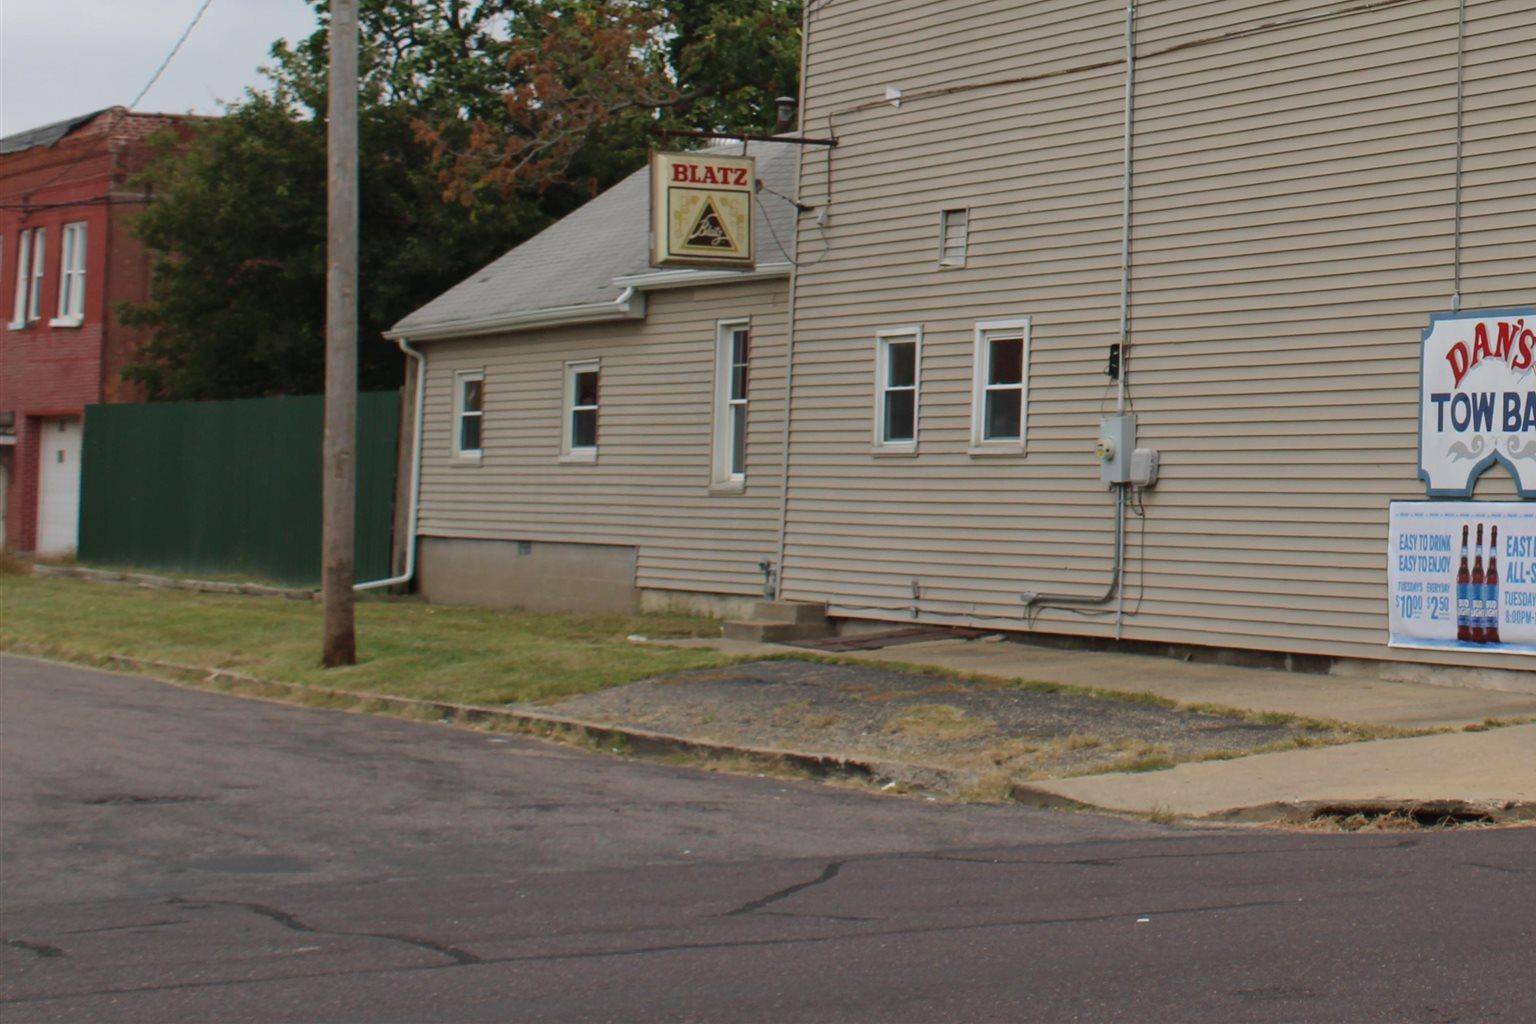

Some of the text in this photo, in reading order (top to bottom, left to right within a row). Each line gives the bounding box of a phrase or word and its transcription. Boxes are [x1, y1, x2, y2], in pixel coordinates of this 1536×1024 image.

[671, 163, 748, 186] BLATZ
[1431, 392, 1496, 433] TOW
[1399, 533, 1452, 551] EASY TO DRINK
[1506, 536, 1533, 557] EAST
[1399, 555, 1451, 573] EASY TO ENJOY
[1504, 591, 1536, 607] TUESDAY
